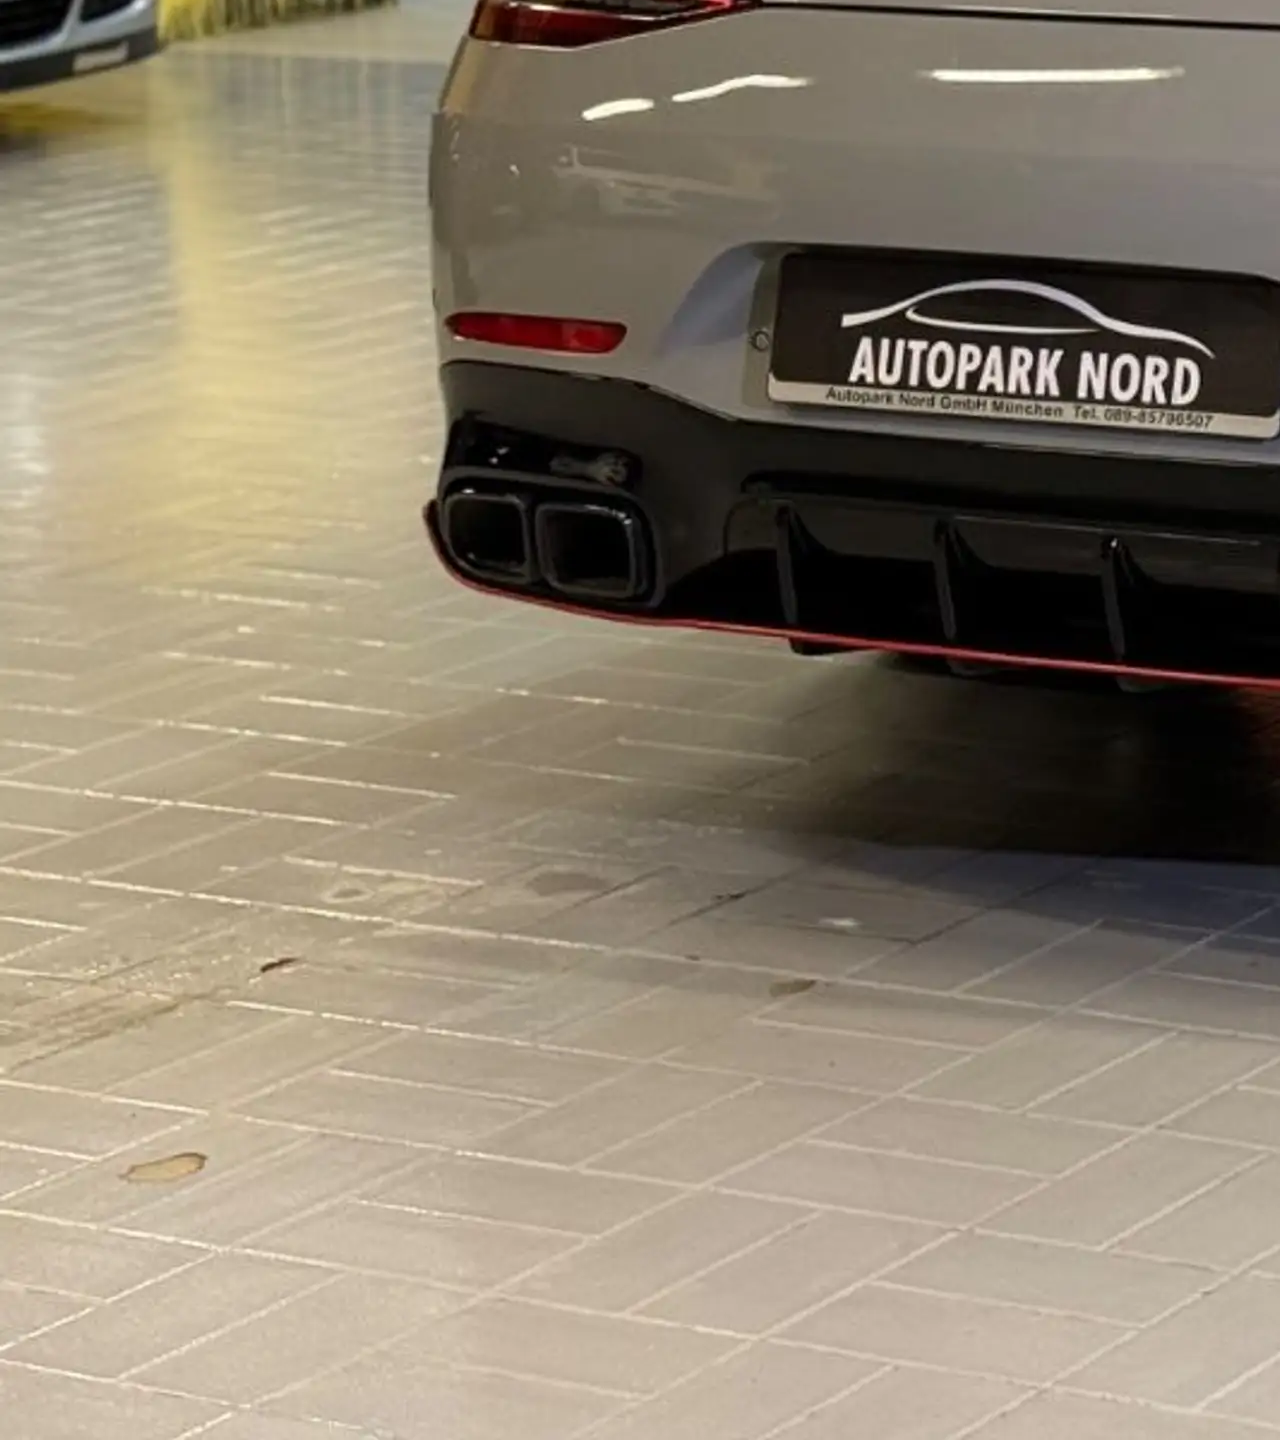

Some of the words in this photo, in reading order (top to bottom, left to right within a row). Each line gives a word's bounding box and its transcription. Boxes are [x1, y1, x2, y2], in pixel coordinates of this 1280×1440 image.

[848, 336, 1064, 397] AUTOPARK
[1076, 351, 1201, 405] NORD
[825, 386, 895, 406] Autopark
[899, 393, 936, 408] Nord
[939, 396, 988, 412] GmbH
[991, 400, 1064, 417] München
[1073, 405, 1100, 421] Tel.
